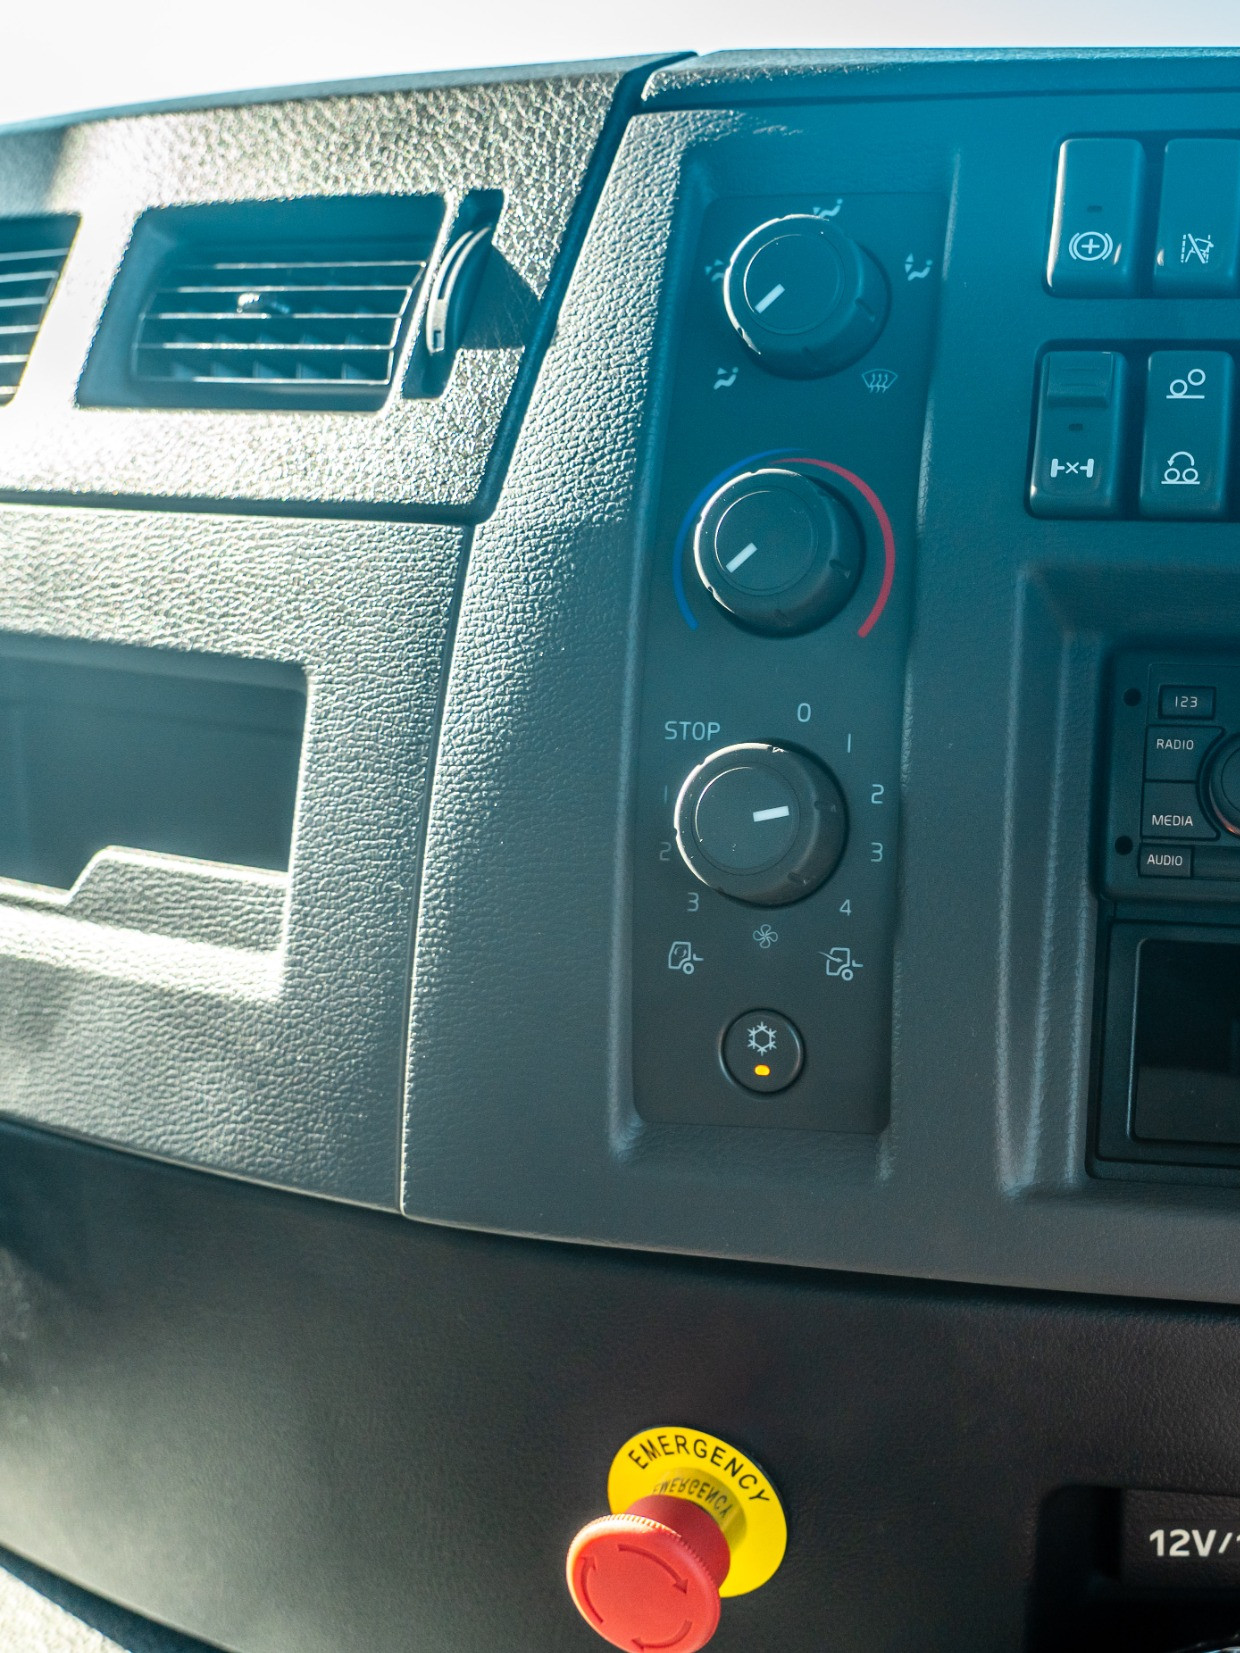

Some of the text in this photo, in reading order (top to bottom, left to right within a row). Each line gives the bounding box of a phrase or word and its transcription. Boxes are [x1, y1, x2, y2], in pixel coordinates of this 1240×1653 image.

[1174, 695, 1199, 709] 123
[796, 702, 812, 723] 0
[664, 720, 721, 741] STOP
[1156, 738, 1194, 751] RADIO
[871, 784, 884, 805] 2
[1151, 814, 1194, 827] MEDIA
[659, 841, 672, 861] 2
[870, 842, 883, 862] 3
[1146, 853, 1184, 867] AUDIO
[687, 891, 699, 912] 3
[839, 899, 852, 917] 4
[628, 1434, 770, 1502] EMERGENCY
